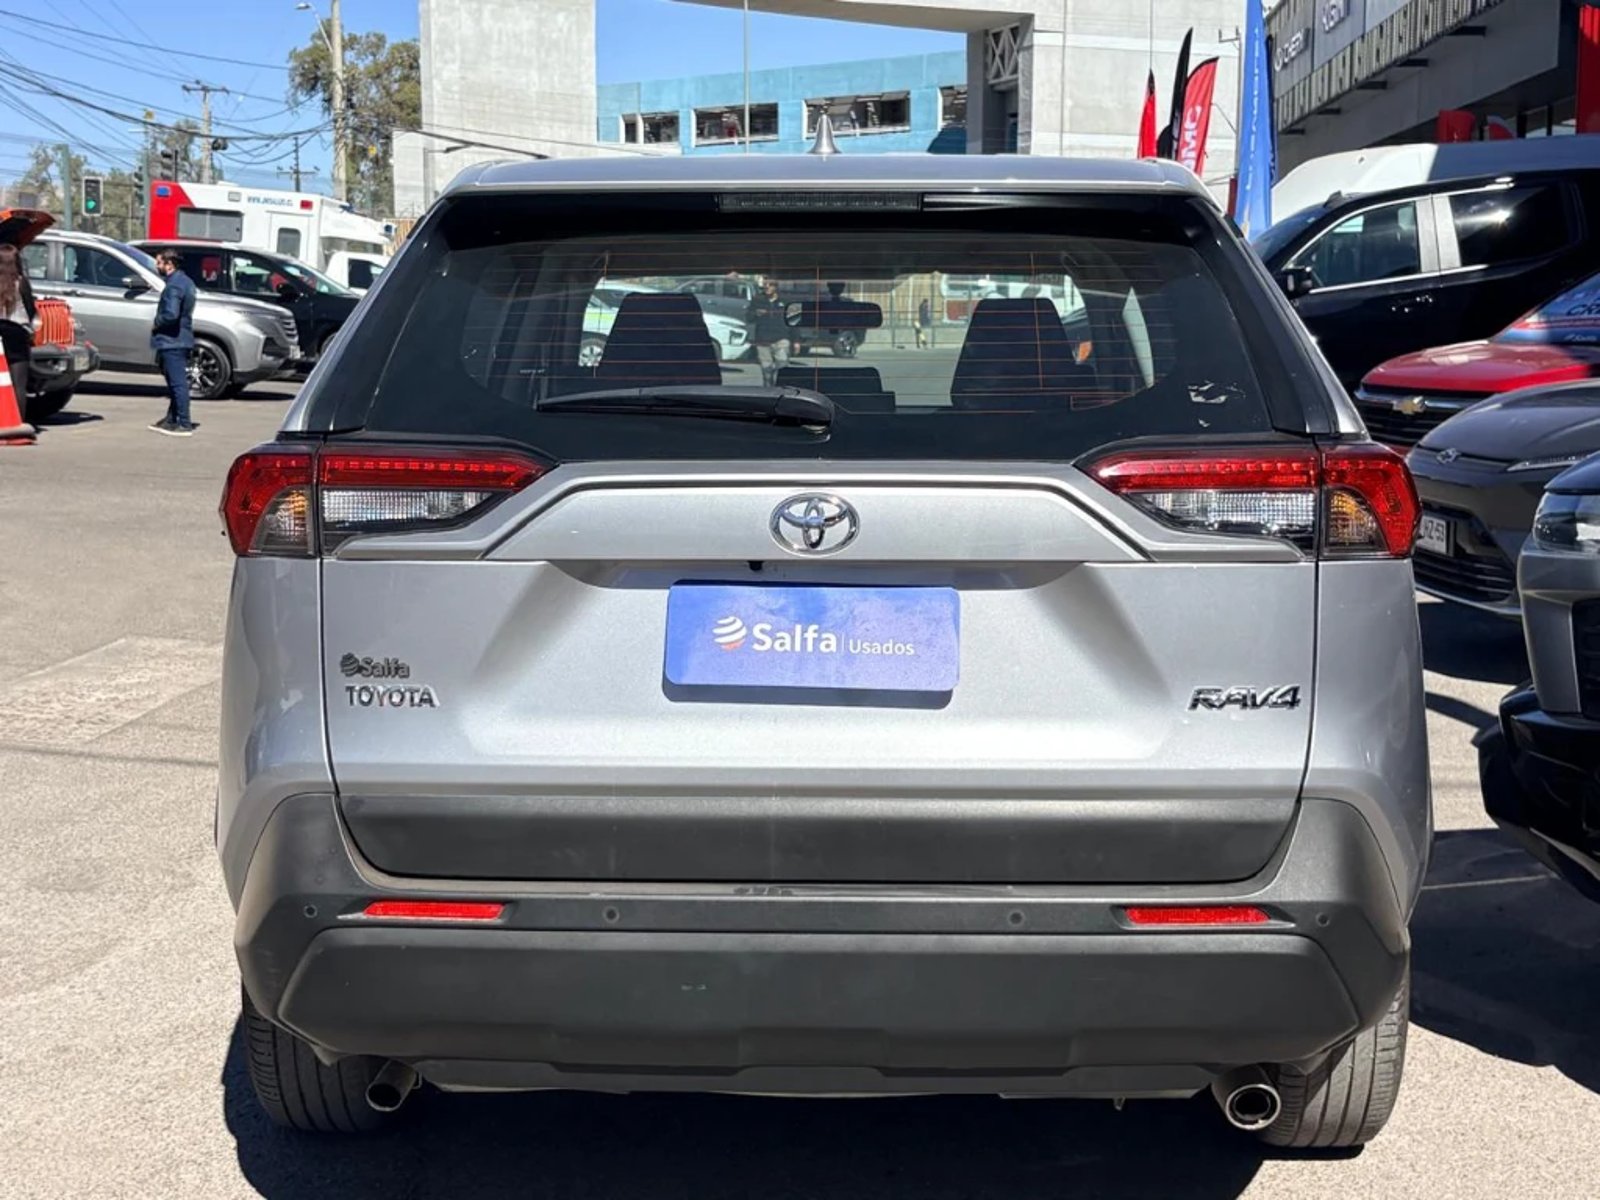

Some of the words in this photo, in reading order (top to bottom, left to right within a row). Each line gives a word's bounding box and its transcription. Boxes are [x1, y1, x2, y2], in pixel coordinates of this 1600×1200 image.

[752, 623, 837, 653] Salfa
[849, 639, 915, 655] Usados
[360, 656, 410, 678] Salfa
[344, 684, 440, 708] TOYOTA
[1185, 684, 1302, 710] RAV4
